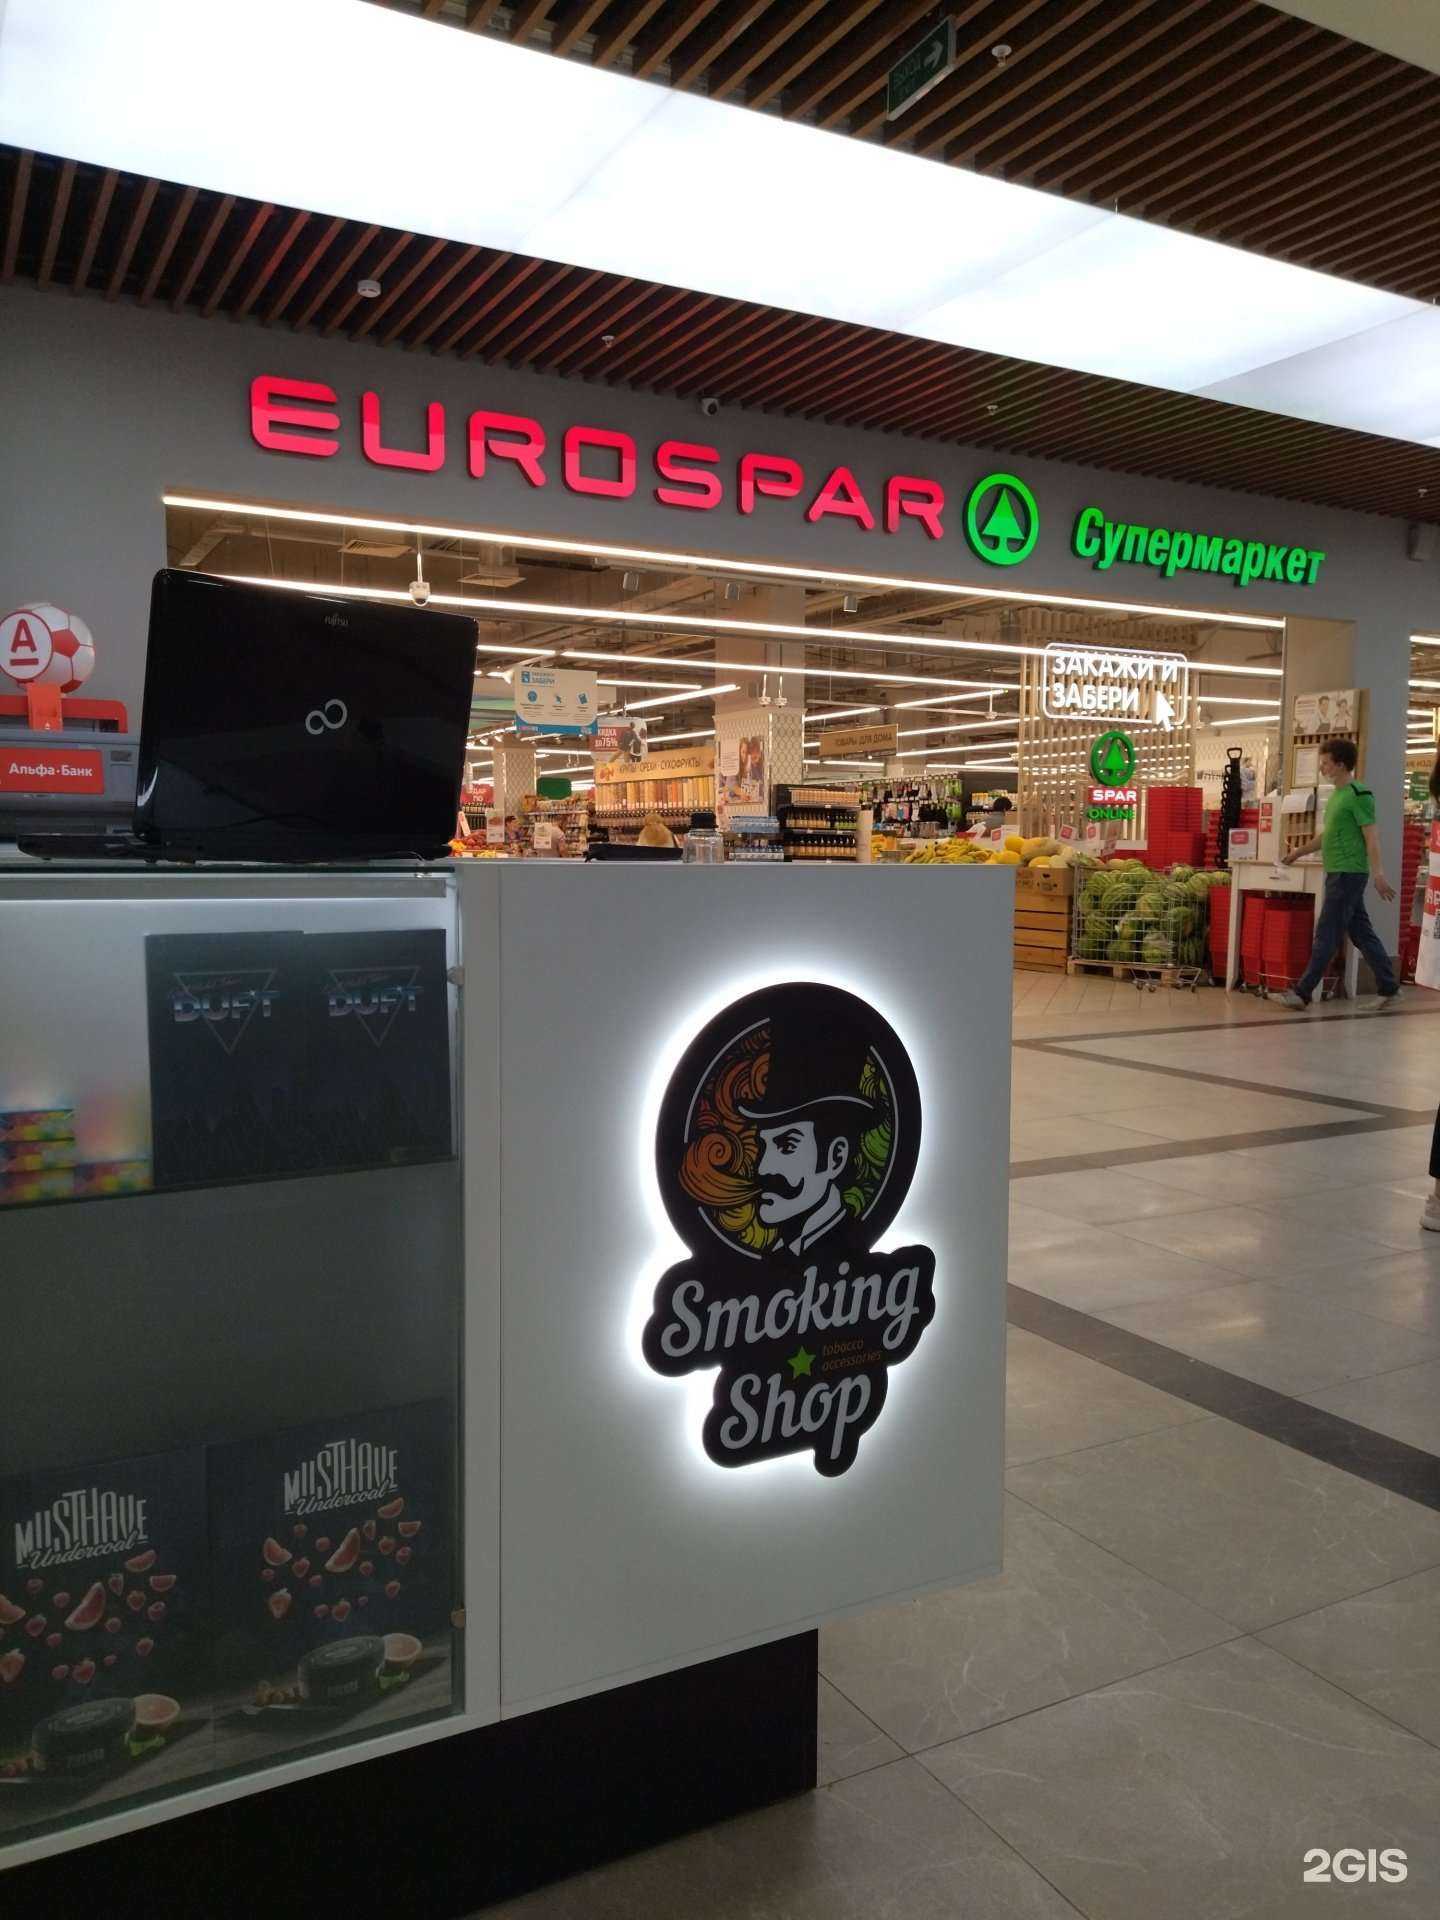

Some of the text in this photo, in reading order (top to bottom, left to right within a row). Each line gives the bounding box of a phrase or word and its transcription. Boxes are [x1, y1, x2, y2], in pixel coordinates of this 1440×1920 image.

[250, 375, 946, 540] EUROSPAR
[1073, 507, 1326, 587] Супермаркет
[1052, 650, 1178, 683] ЗАКАЖИ И
[1052, 682, 1140, 712] ЗАБЕРИ
[1092, 789, 1137, 802] SPAR
[661, 1261, 921, 1358] Smoking
[719, 1370, 872, 1460] Shop
